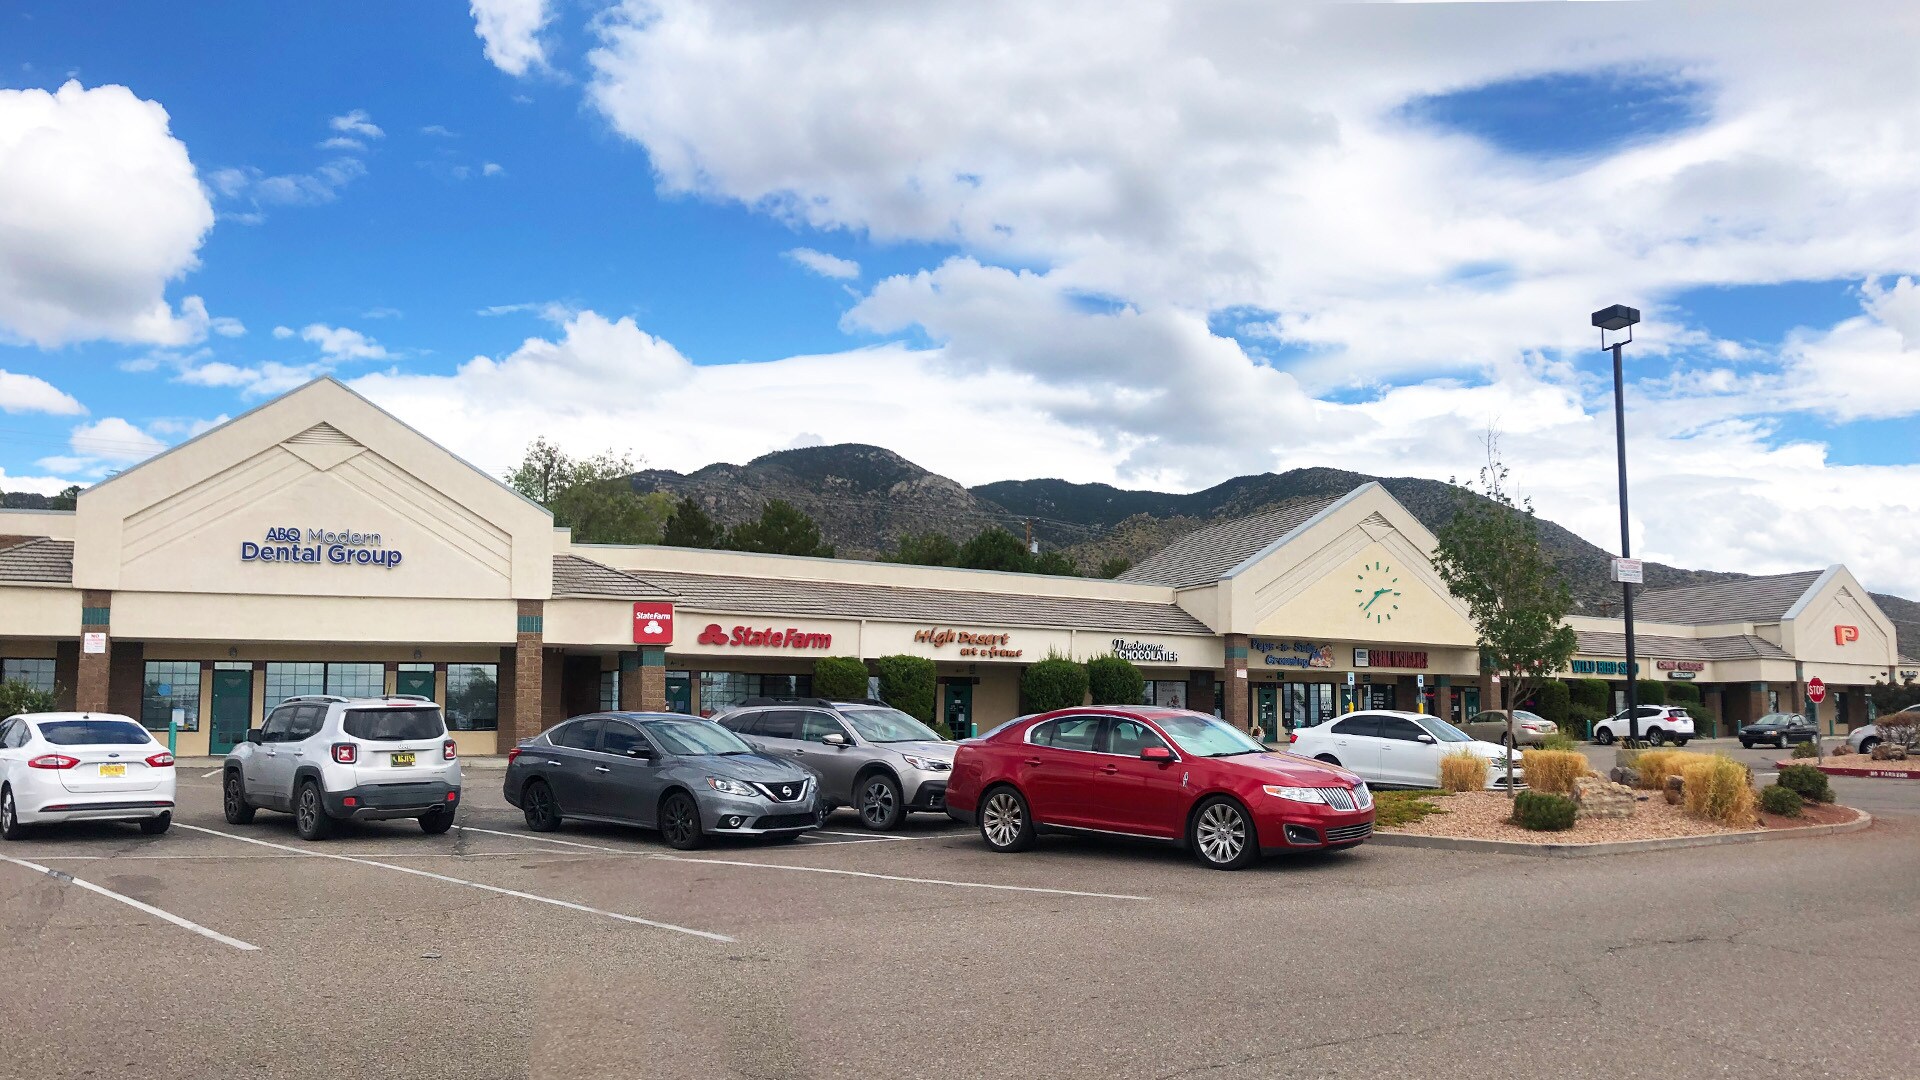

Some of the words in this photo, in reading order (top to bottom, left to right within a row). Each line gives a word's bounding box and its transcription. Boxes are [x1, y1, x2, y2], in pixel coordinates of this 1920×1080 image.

[265, 527, 301, 542] ABQ
[307, 528, 382, 545] Modern
[241, 541, 322, 563] Dental
[327, 544, 403, 569] Group
[914, 627, 956, 647] High
[958, 631, 1010, 646] Desert
[960, 647, 978, 656] art
[989, 645, 1022, 658] frame
[1118, 650, 1180, 662] CHOCOLATIER
[1571, 660, 1595, 673] WILD
[1596, 661, 1617, 674] BIRD
[1809, 686, 1825, 695] STOP
